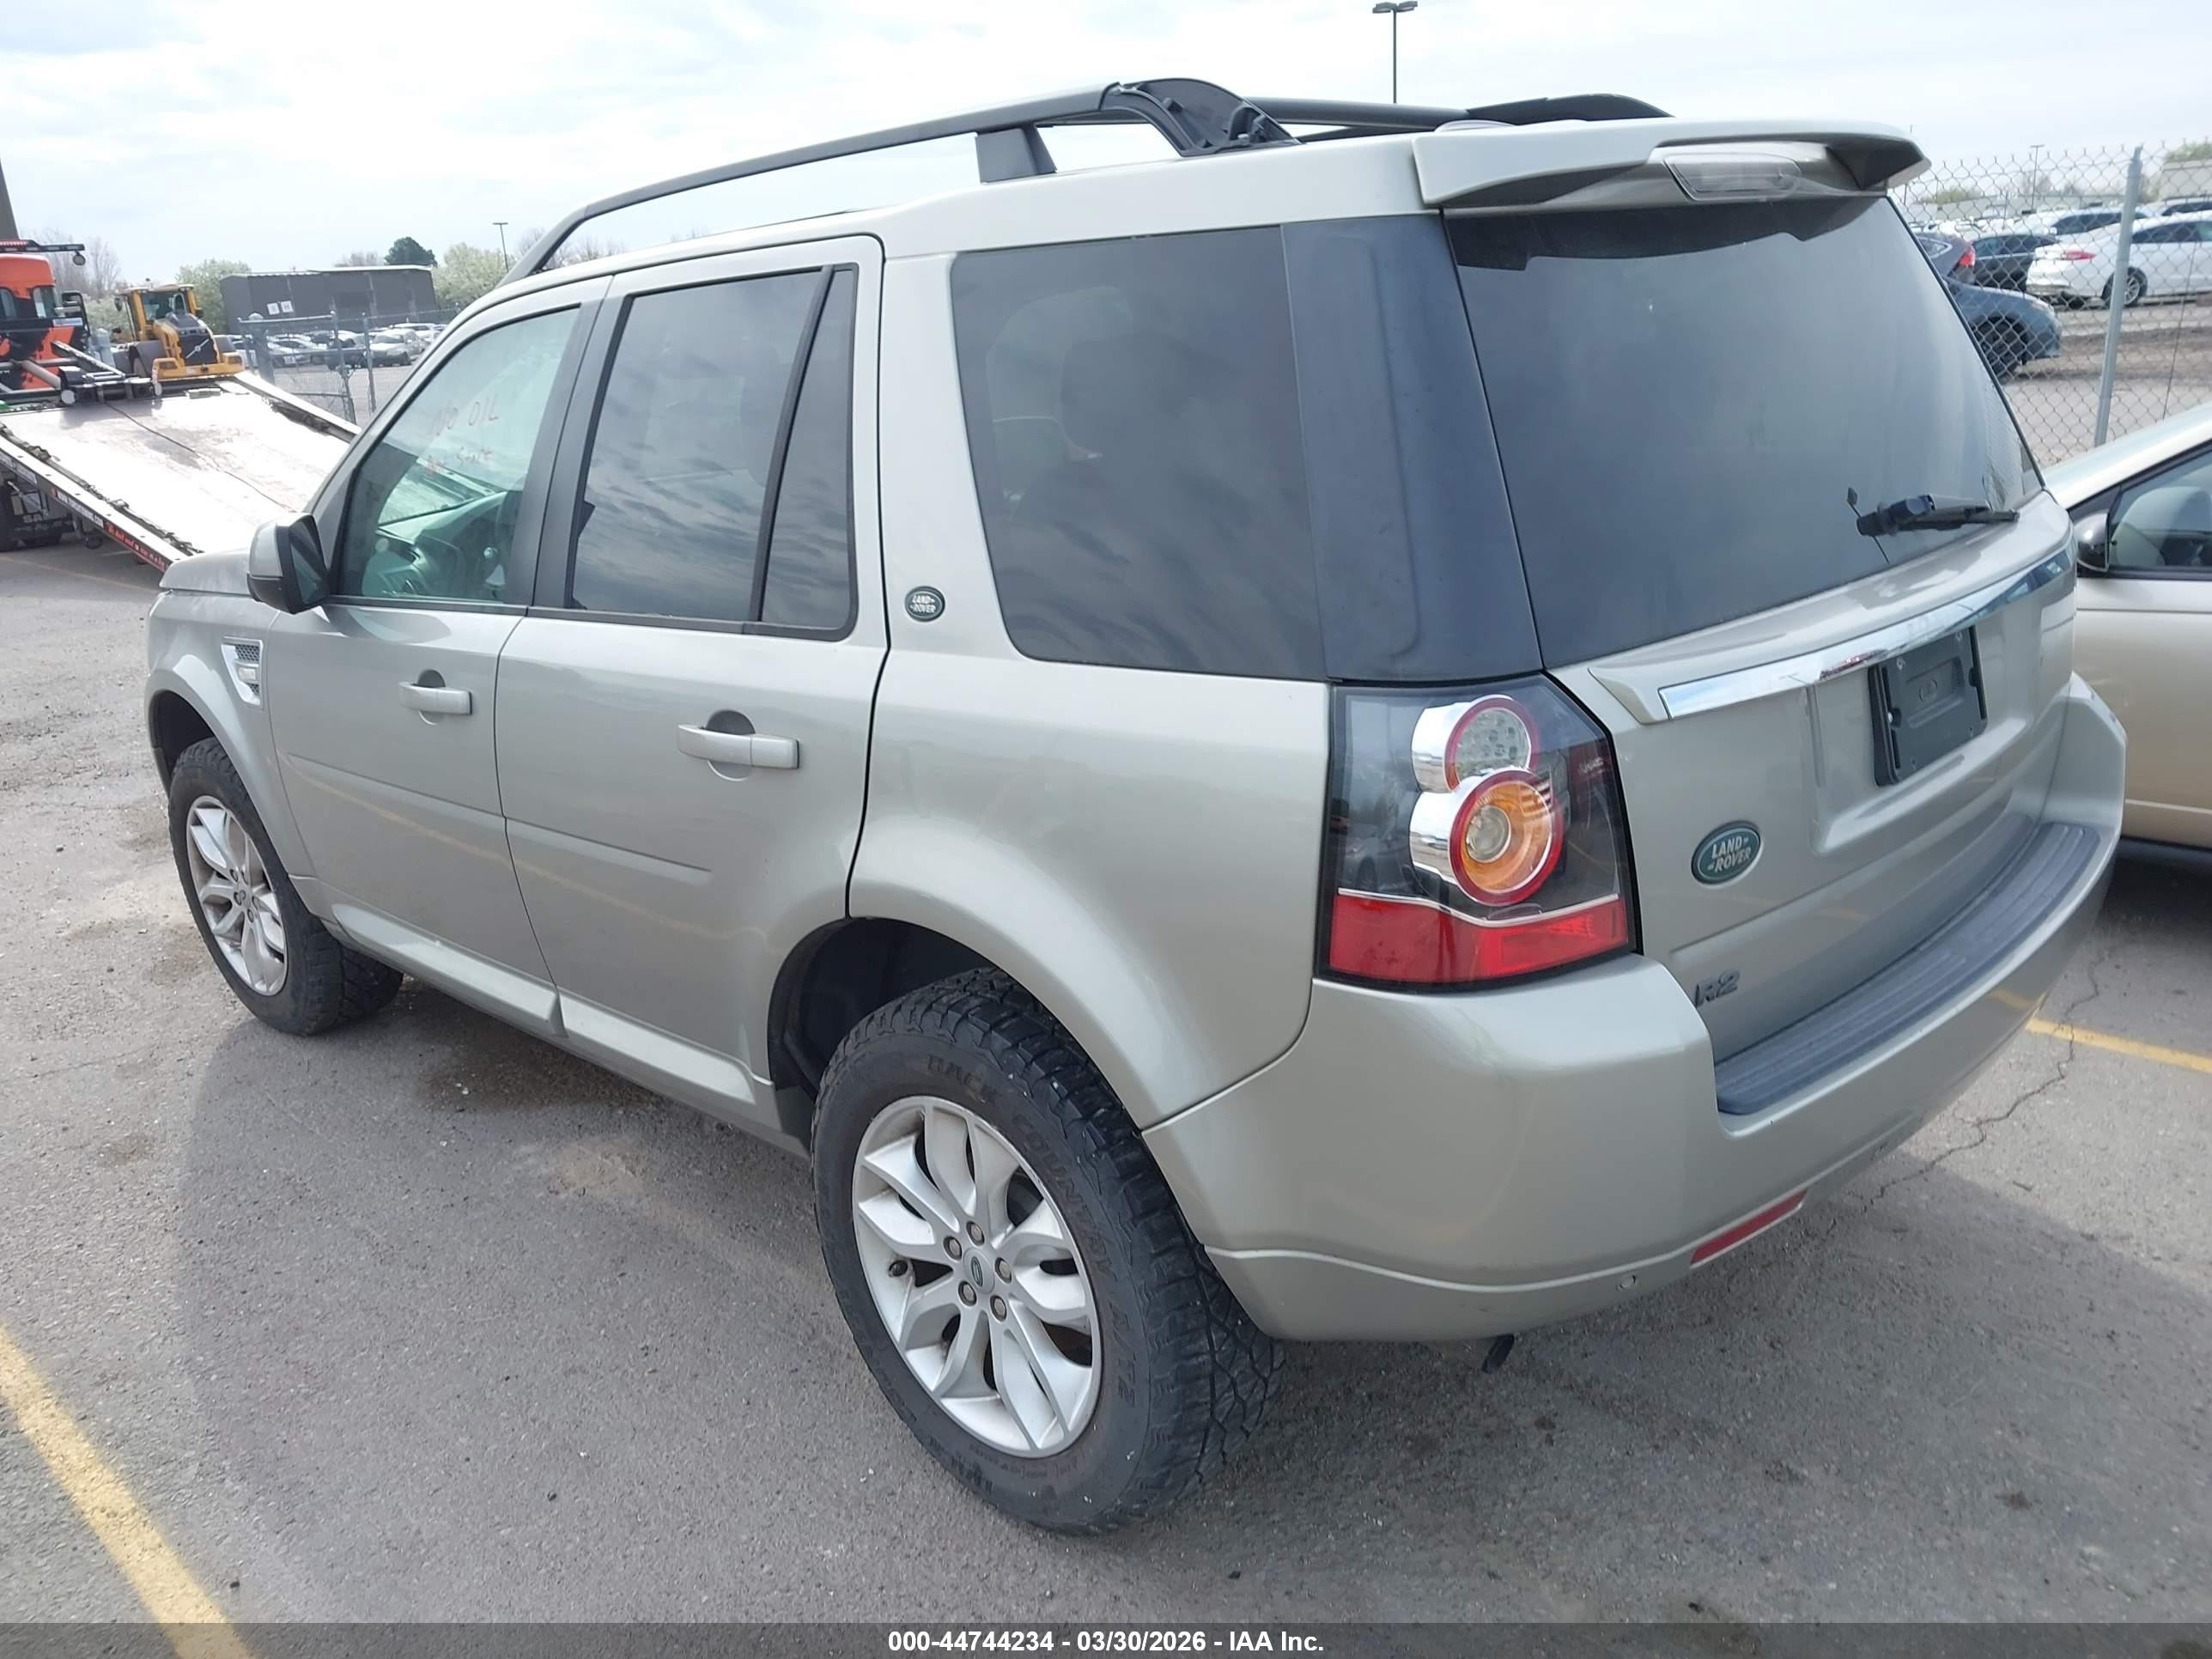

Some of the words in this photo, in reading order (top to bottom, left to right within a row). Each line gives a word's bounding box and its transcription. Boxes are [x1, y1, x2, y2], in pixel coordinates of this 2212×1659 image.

[468, 392, 499, 427] OIL
[912, 595, 933, 605] LAND
[913, 604, 936, 613] ROVER
[1711, 836, 1743, 860] LAND
[1714, 846, 1752, 873] ROVER
[1012, 1113, 1119, 1284] COUNTRY
